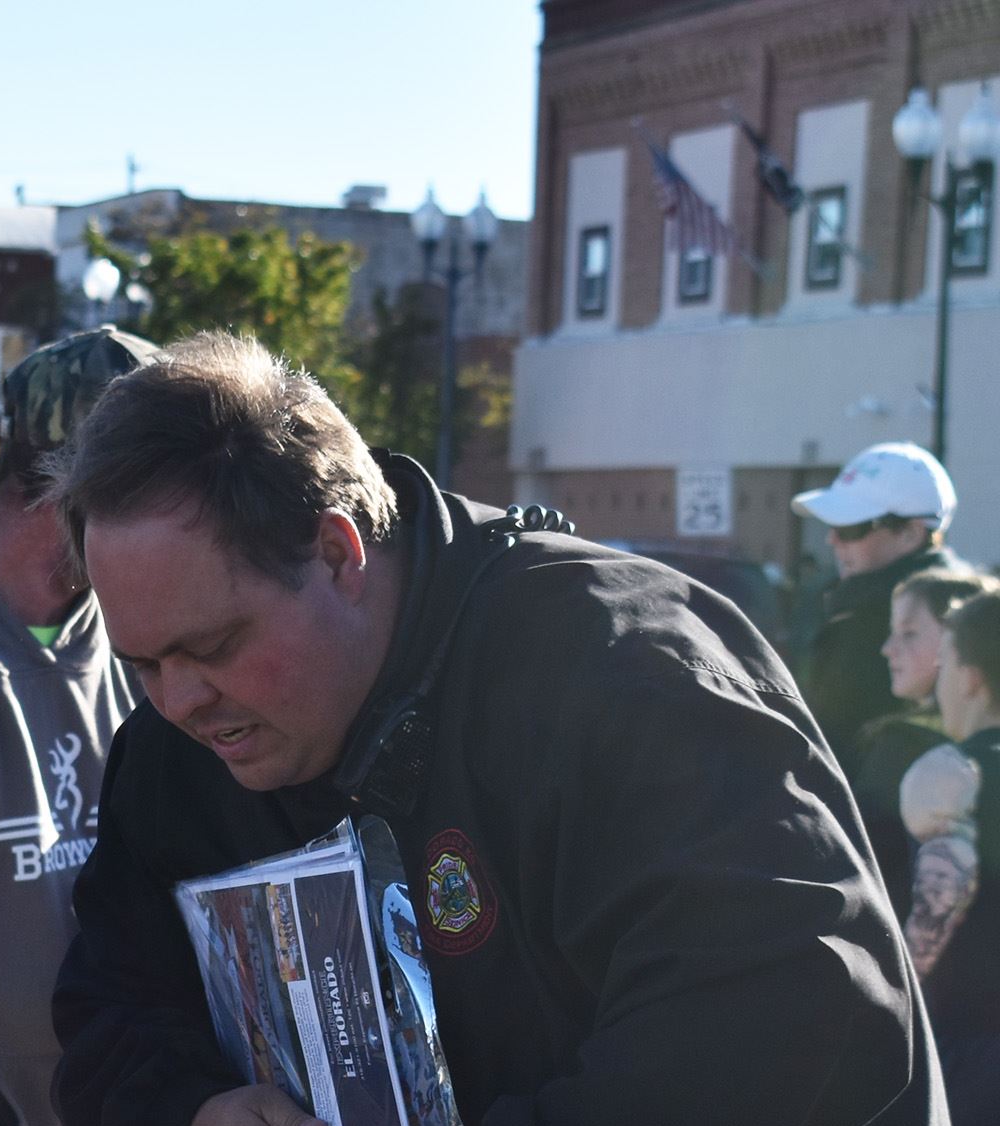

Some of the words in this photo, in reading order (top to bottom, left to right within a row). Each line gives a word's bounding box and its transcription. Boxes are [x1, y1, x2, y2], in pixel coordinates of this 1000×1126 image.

[11, 837, 98, 882] BROWN
[324, 956, 349, 1046] DORADO
[344, 1052, 356, 1077] EL
